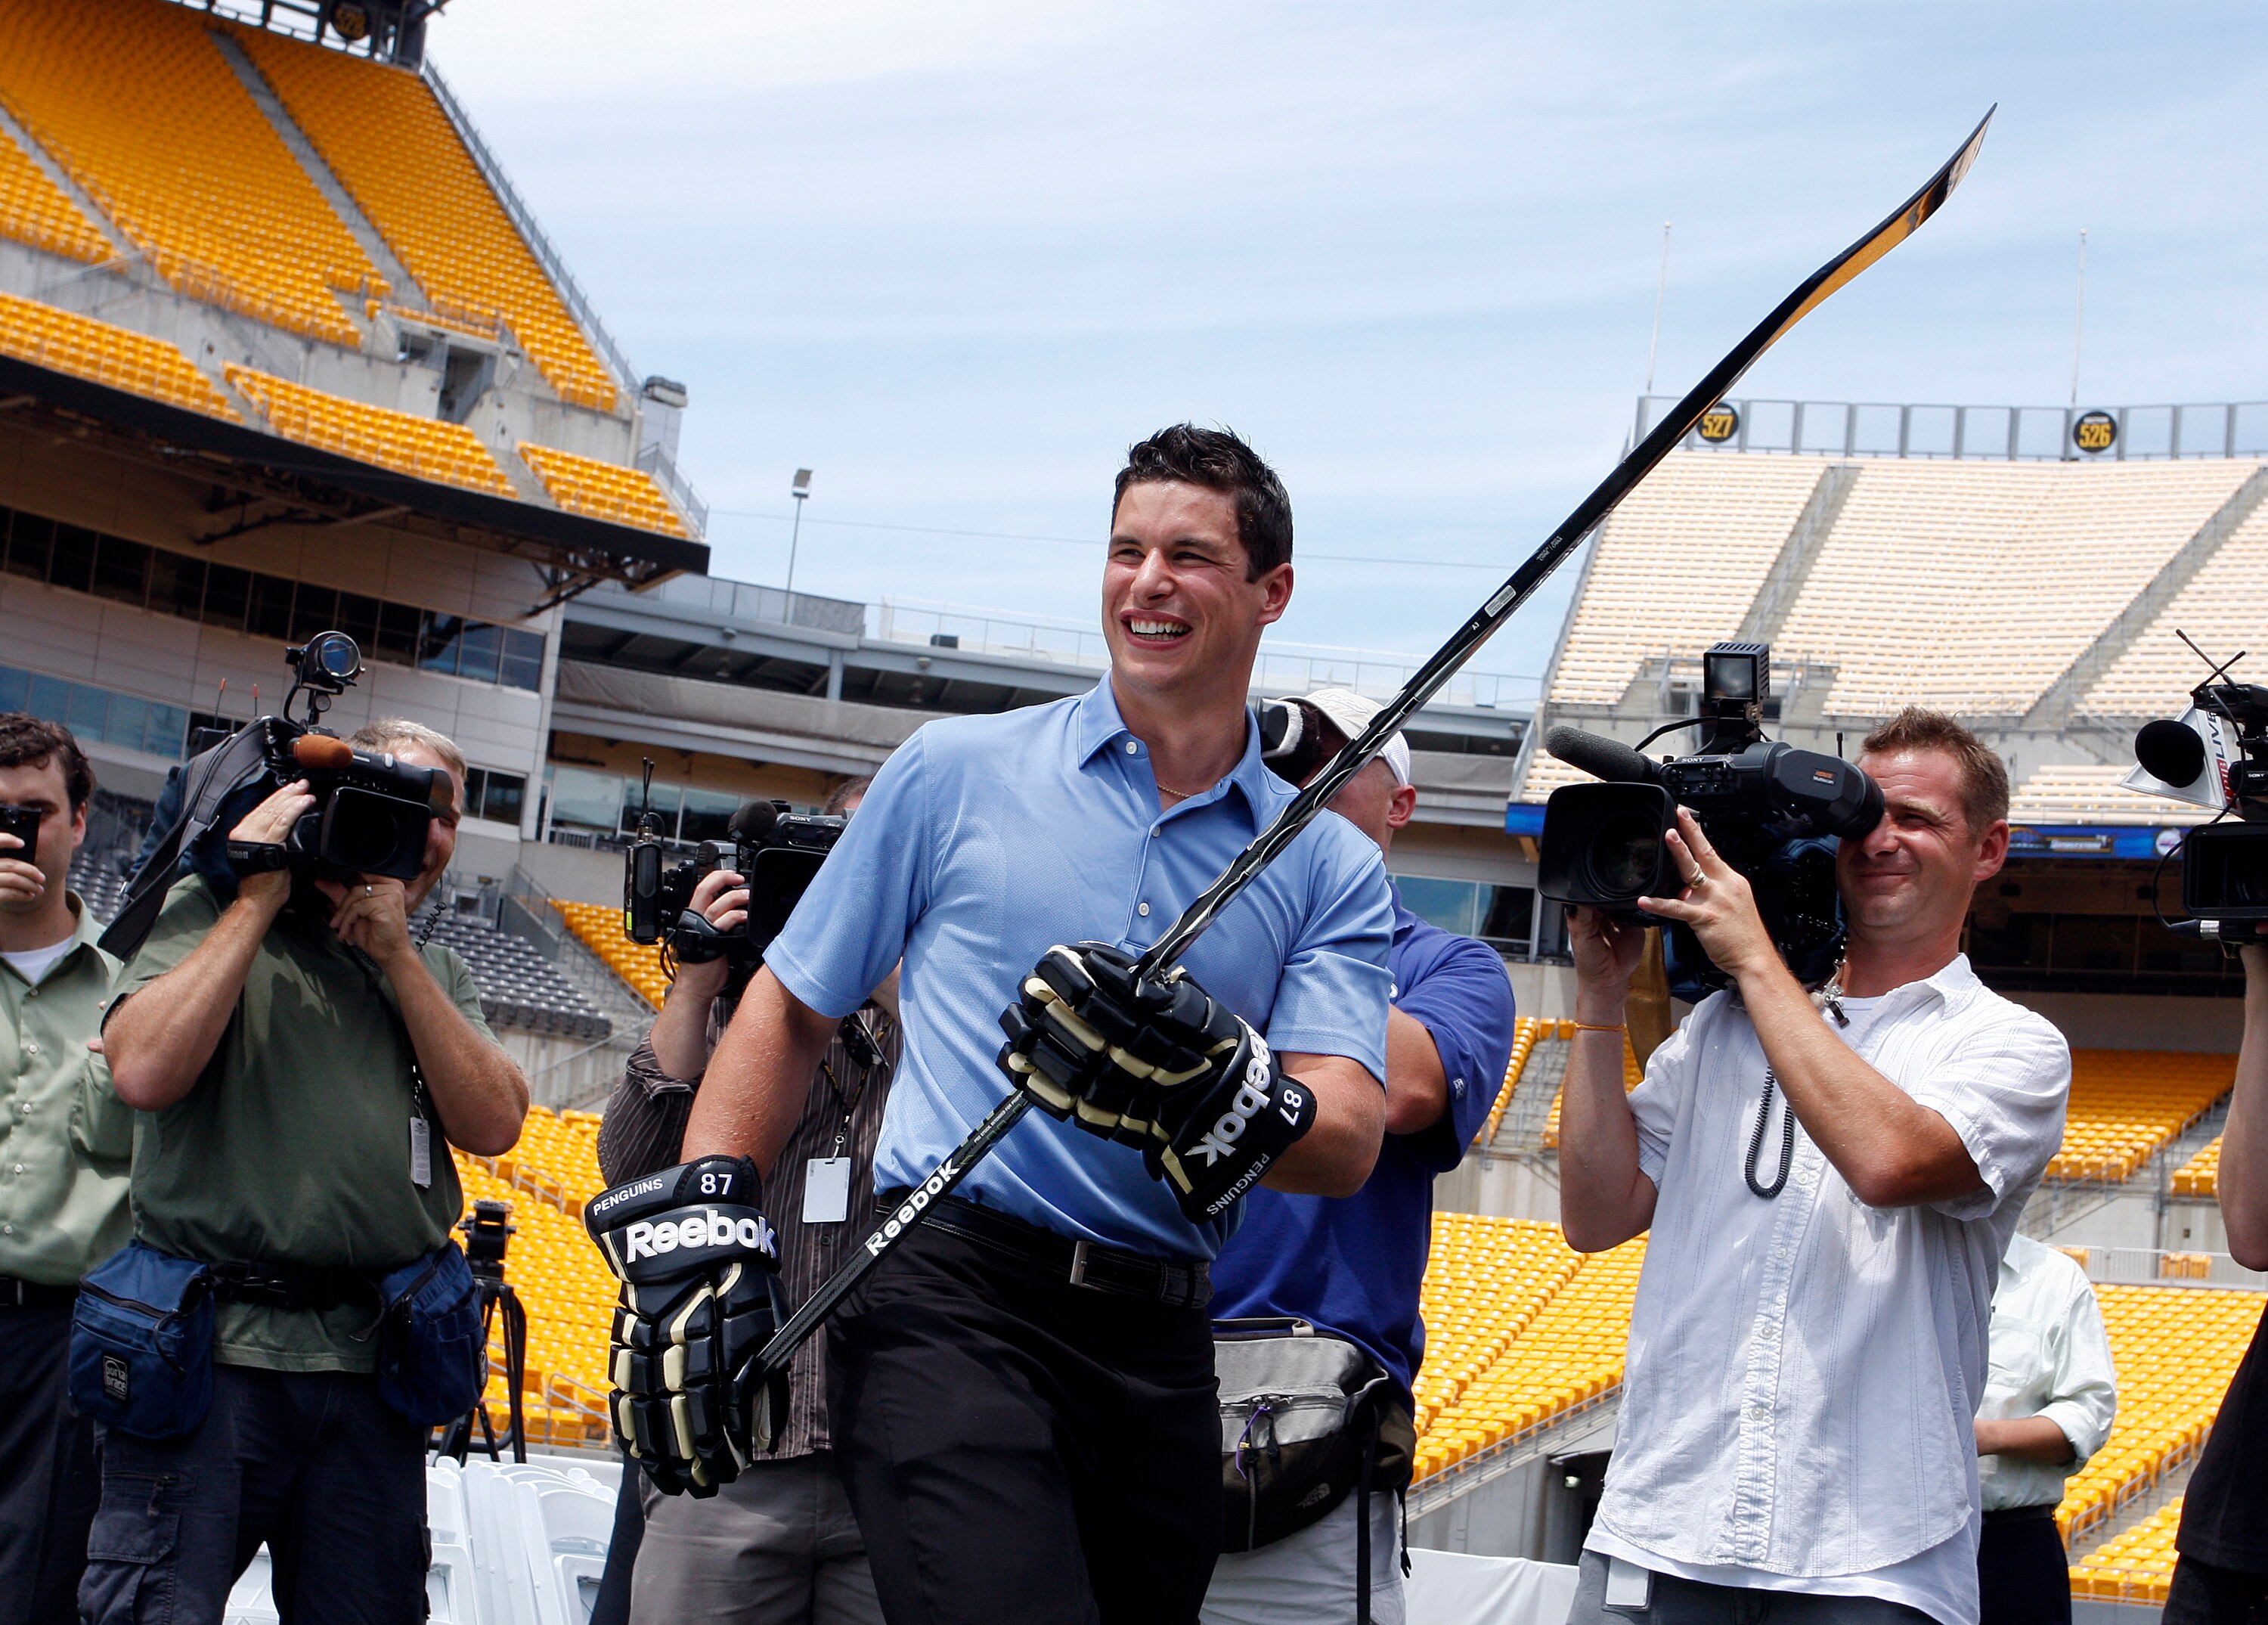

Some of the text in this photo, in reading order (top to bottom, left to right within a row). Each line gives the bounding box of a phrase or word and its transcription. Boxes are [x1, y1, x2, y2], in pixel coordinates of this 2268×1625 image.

[1702, 414, 1734, 438] 527
[2078, 423, 2111, 448] 526
[1278, 1089, 1303, 1127] 87
[593, 1173, 733, 1216] PENGUINS 87
[1206, 1152, 1271, 1216] PENGUINS
[865, 1158, 961, 1257] Reebok
[626, 1208, 776, 1264] Reebok
